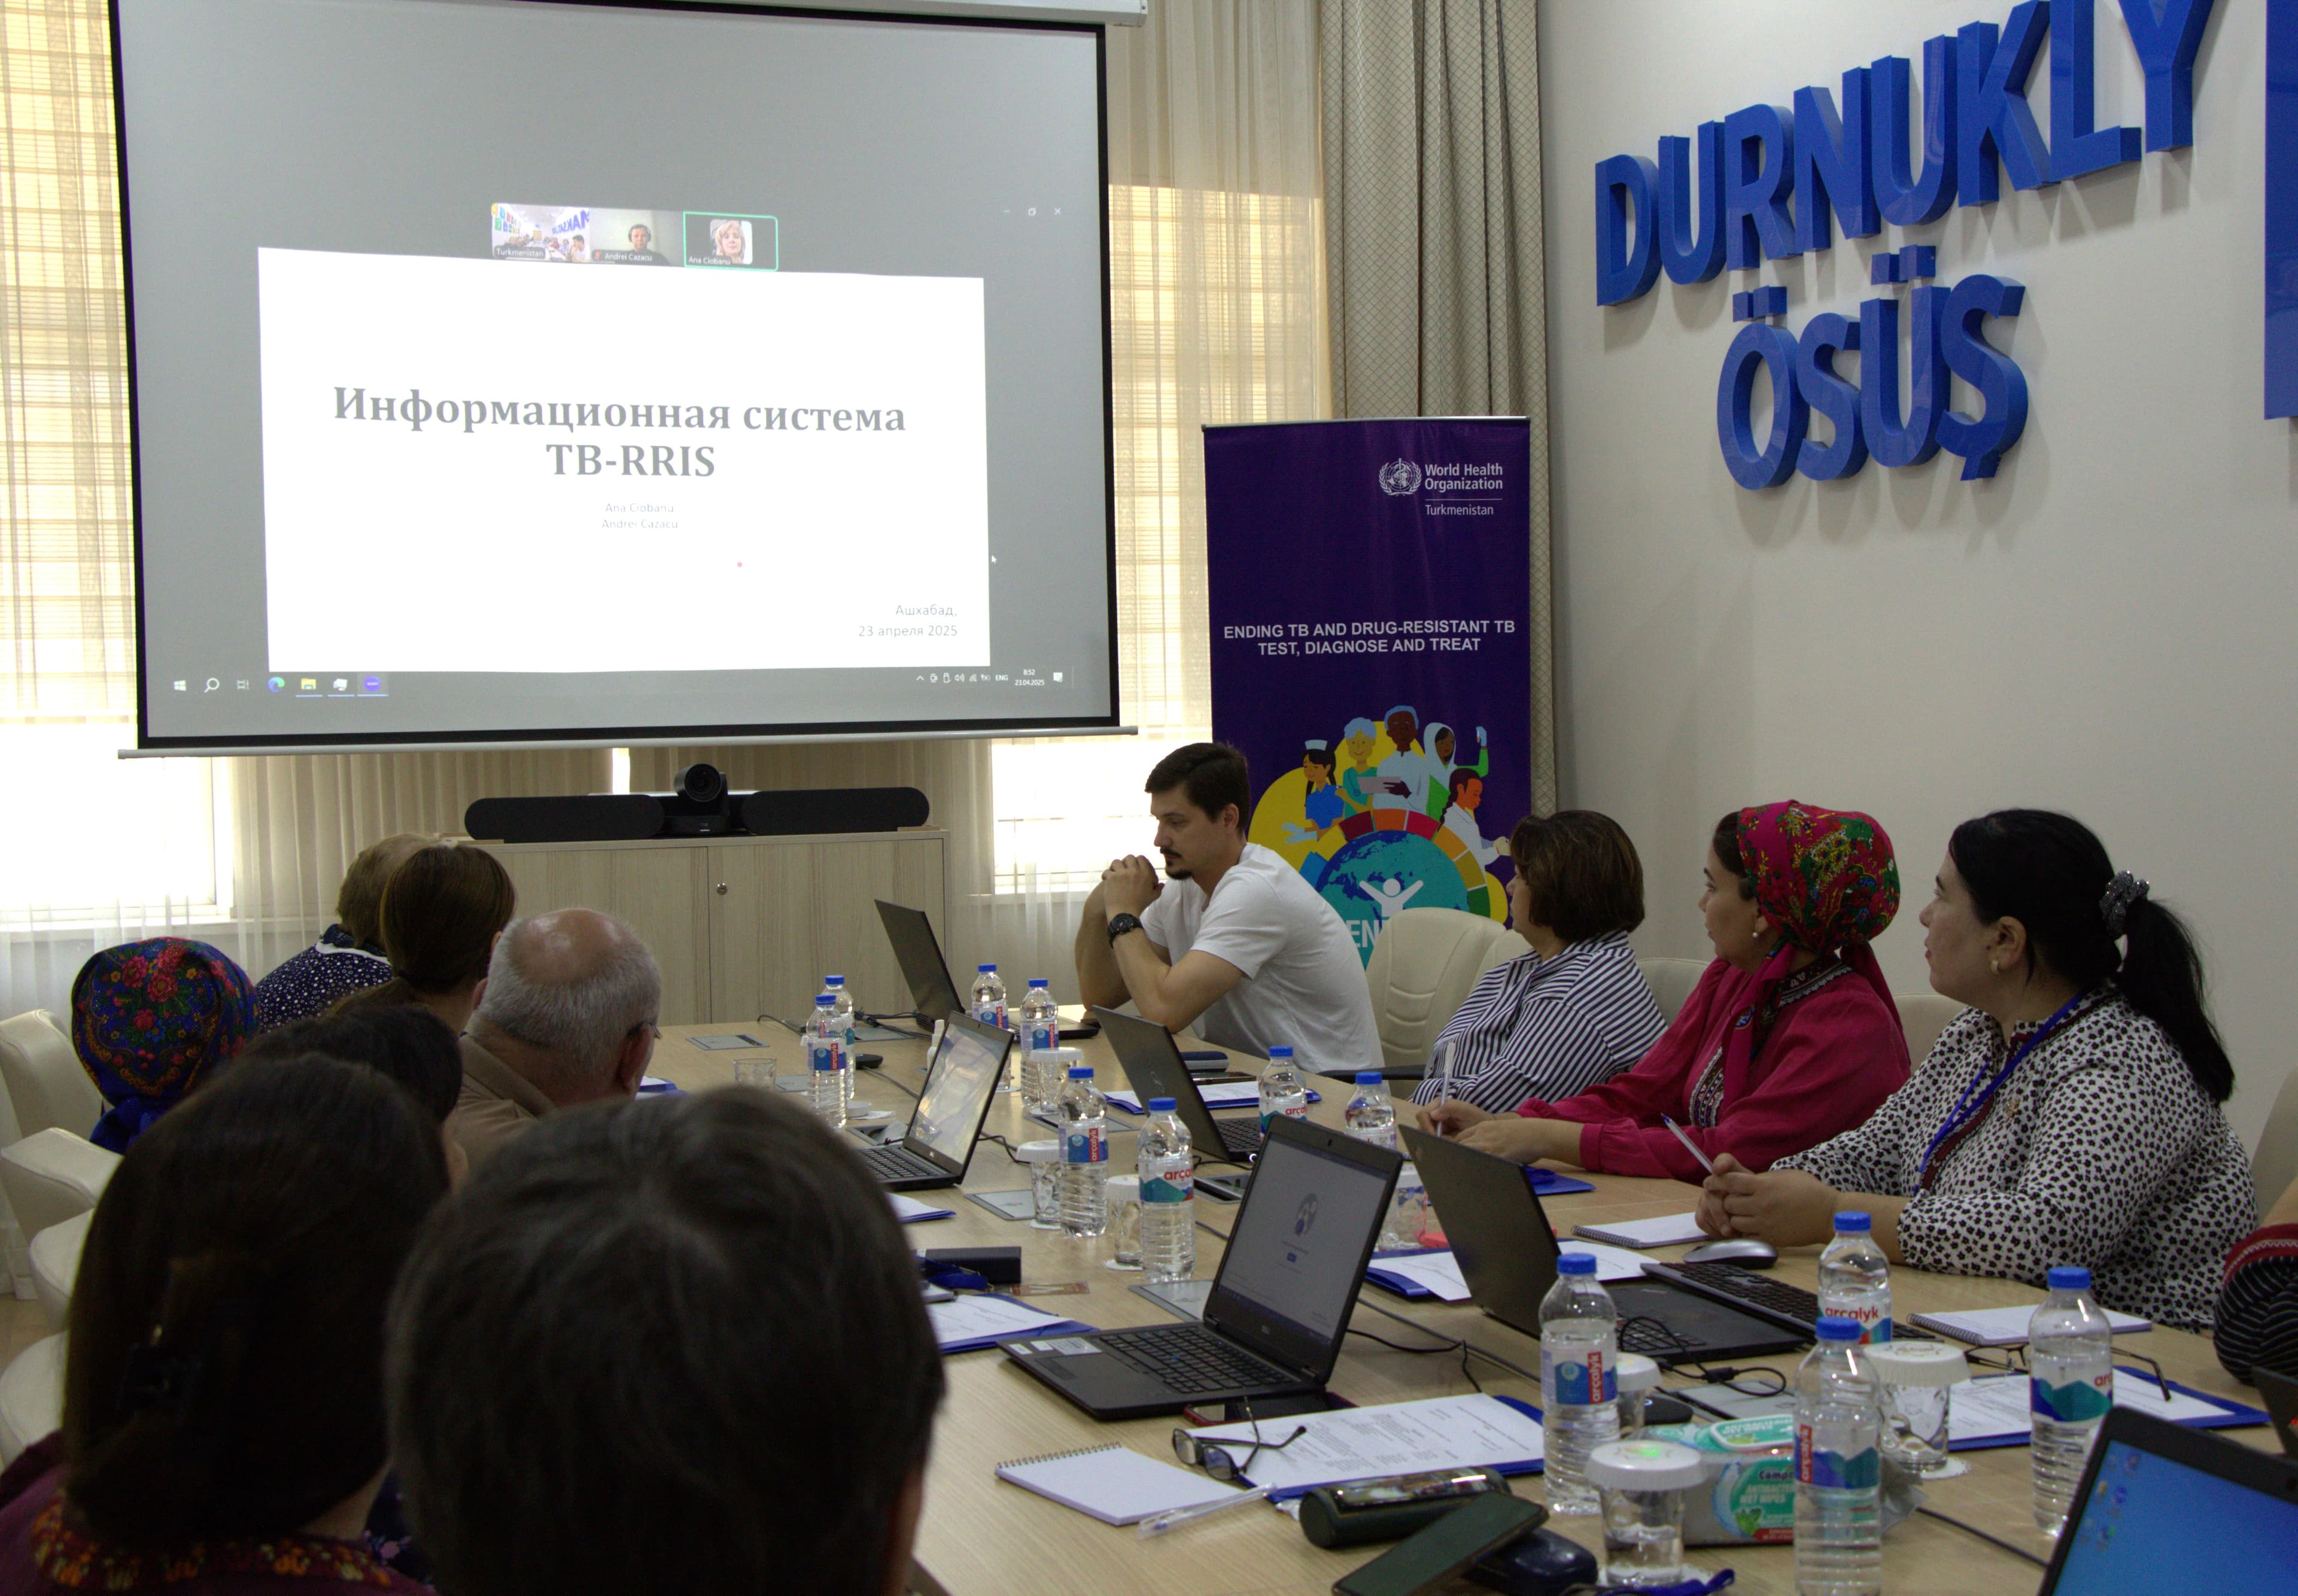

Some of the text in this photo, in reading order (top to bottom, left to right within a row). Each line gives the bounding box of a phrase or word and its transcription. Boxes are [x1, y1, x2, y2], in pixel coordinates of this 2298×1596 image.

[1595, 0, 2214, 306] DURNUKLY
[496, 248, 543, 259] Turkmenistan
[628, 253, 652, 262] Cazacu
[703, 257, 731, 266] Ciobanu
[1717, 245, 2029, 491] ÖSÜŞ
[333, 387, 906, 433] Информационная система
[546, 444, 715, 477] TB-RRIS
[1424, 462, 1503, 476] World Health
[1424, 477, 1503, 493] Organization
[605, 502, 674, 513] Ana Ciobanu
[1425, 503, 1494, 516] Turkmenistan
[601, 519, 678, 529] Andrei Cazacu
[895, 604, 957, 618] Ашхабад,
[859, 625, 957, 639] 23 апреля 2025
[1224, 619, 1515, 639] ENDING TB AND DRUG-RESISTANT TB
[1257, 637, 1481, 657] TEST, DIAGNOSE AND TREAT
